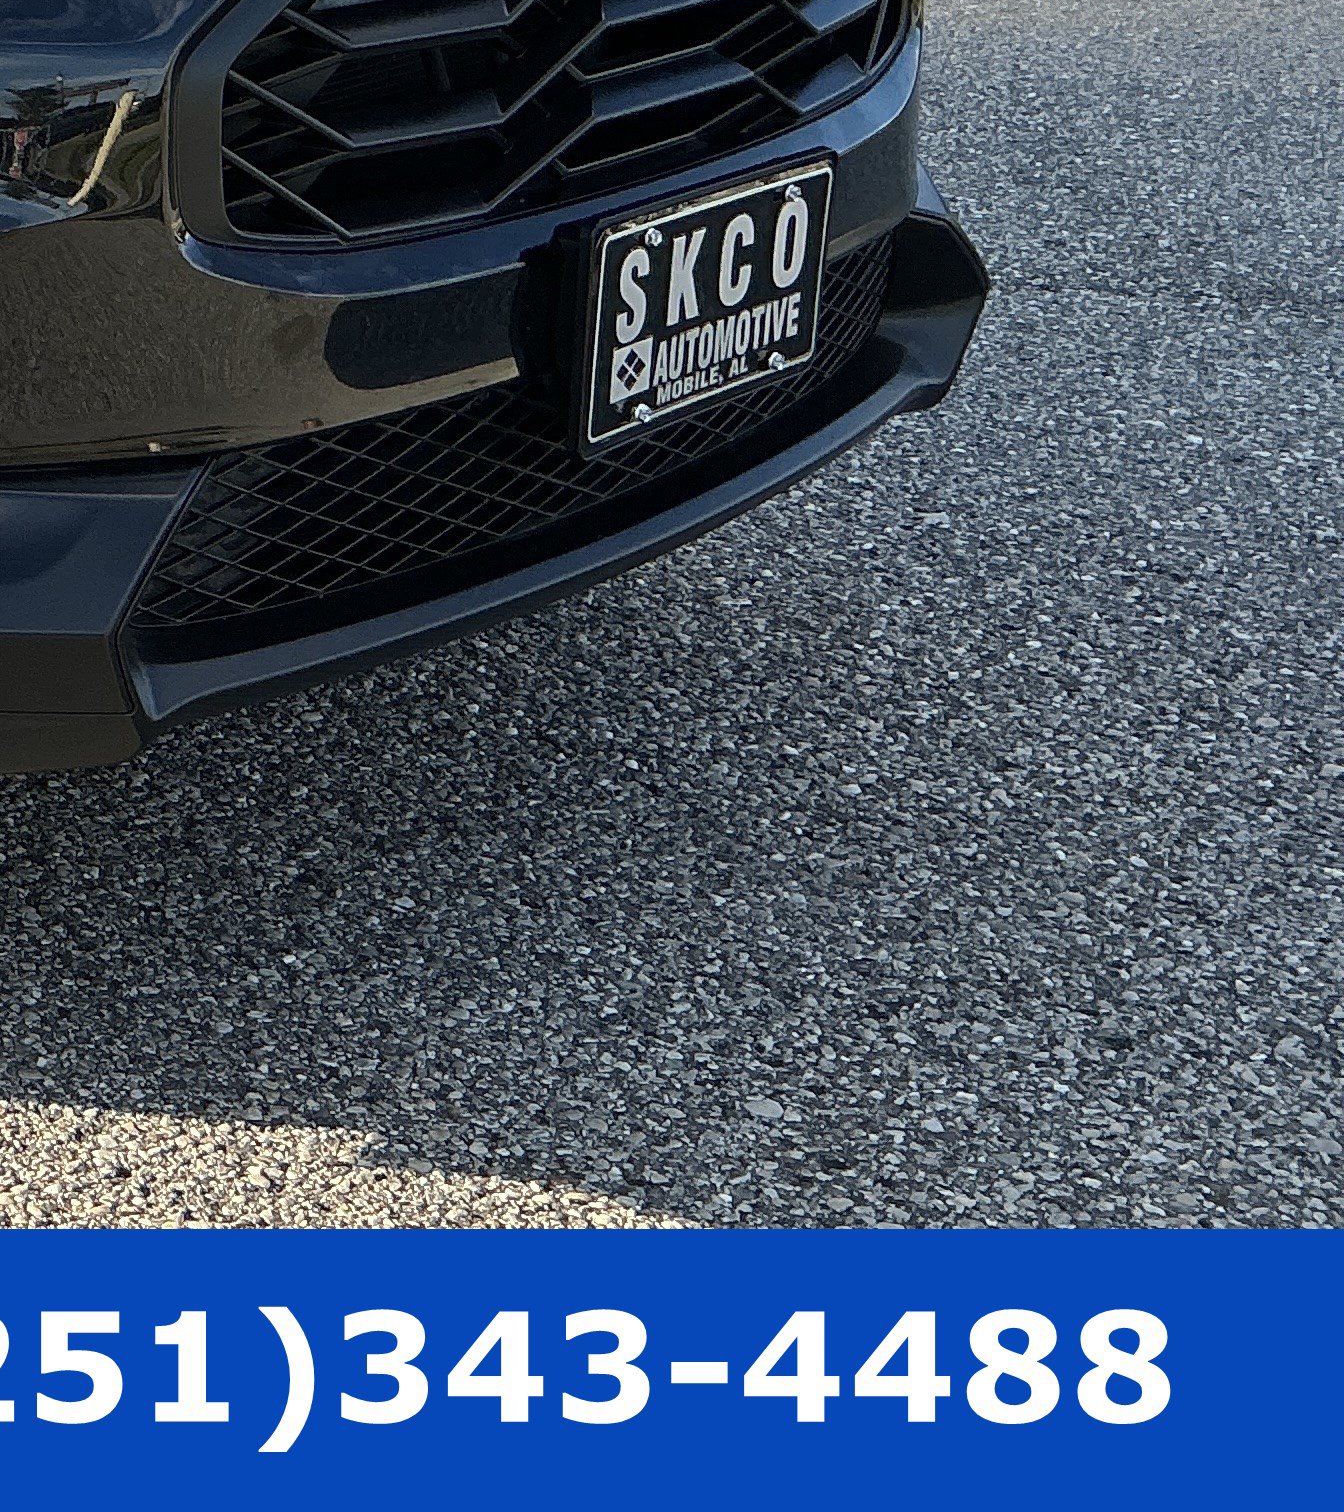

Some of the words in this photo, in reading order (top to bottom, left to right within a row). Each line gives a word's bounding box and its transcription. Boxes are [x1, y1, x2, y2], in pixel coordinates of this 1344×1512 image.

[615, 197, 808, 345] SKCO
[652, 291, 802, 387] AUTOMOTIVE
[656, 364, 724, 406] MOBILE,
[728, 354, 749, 378] AL
